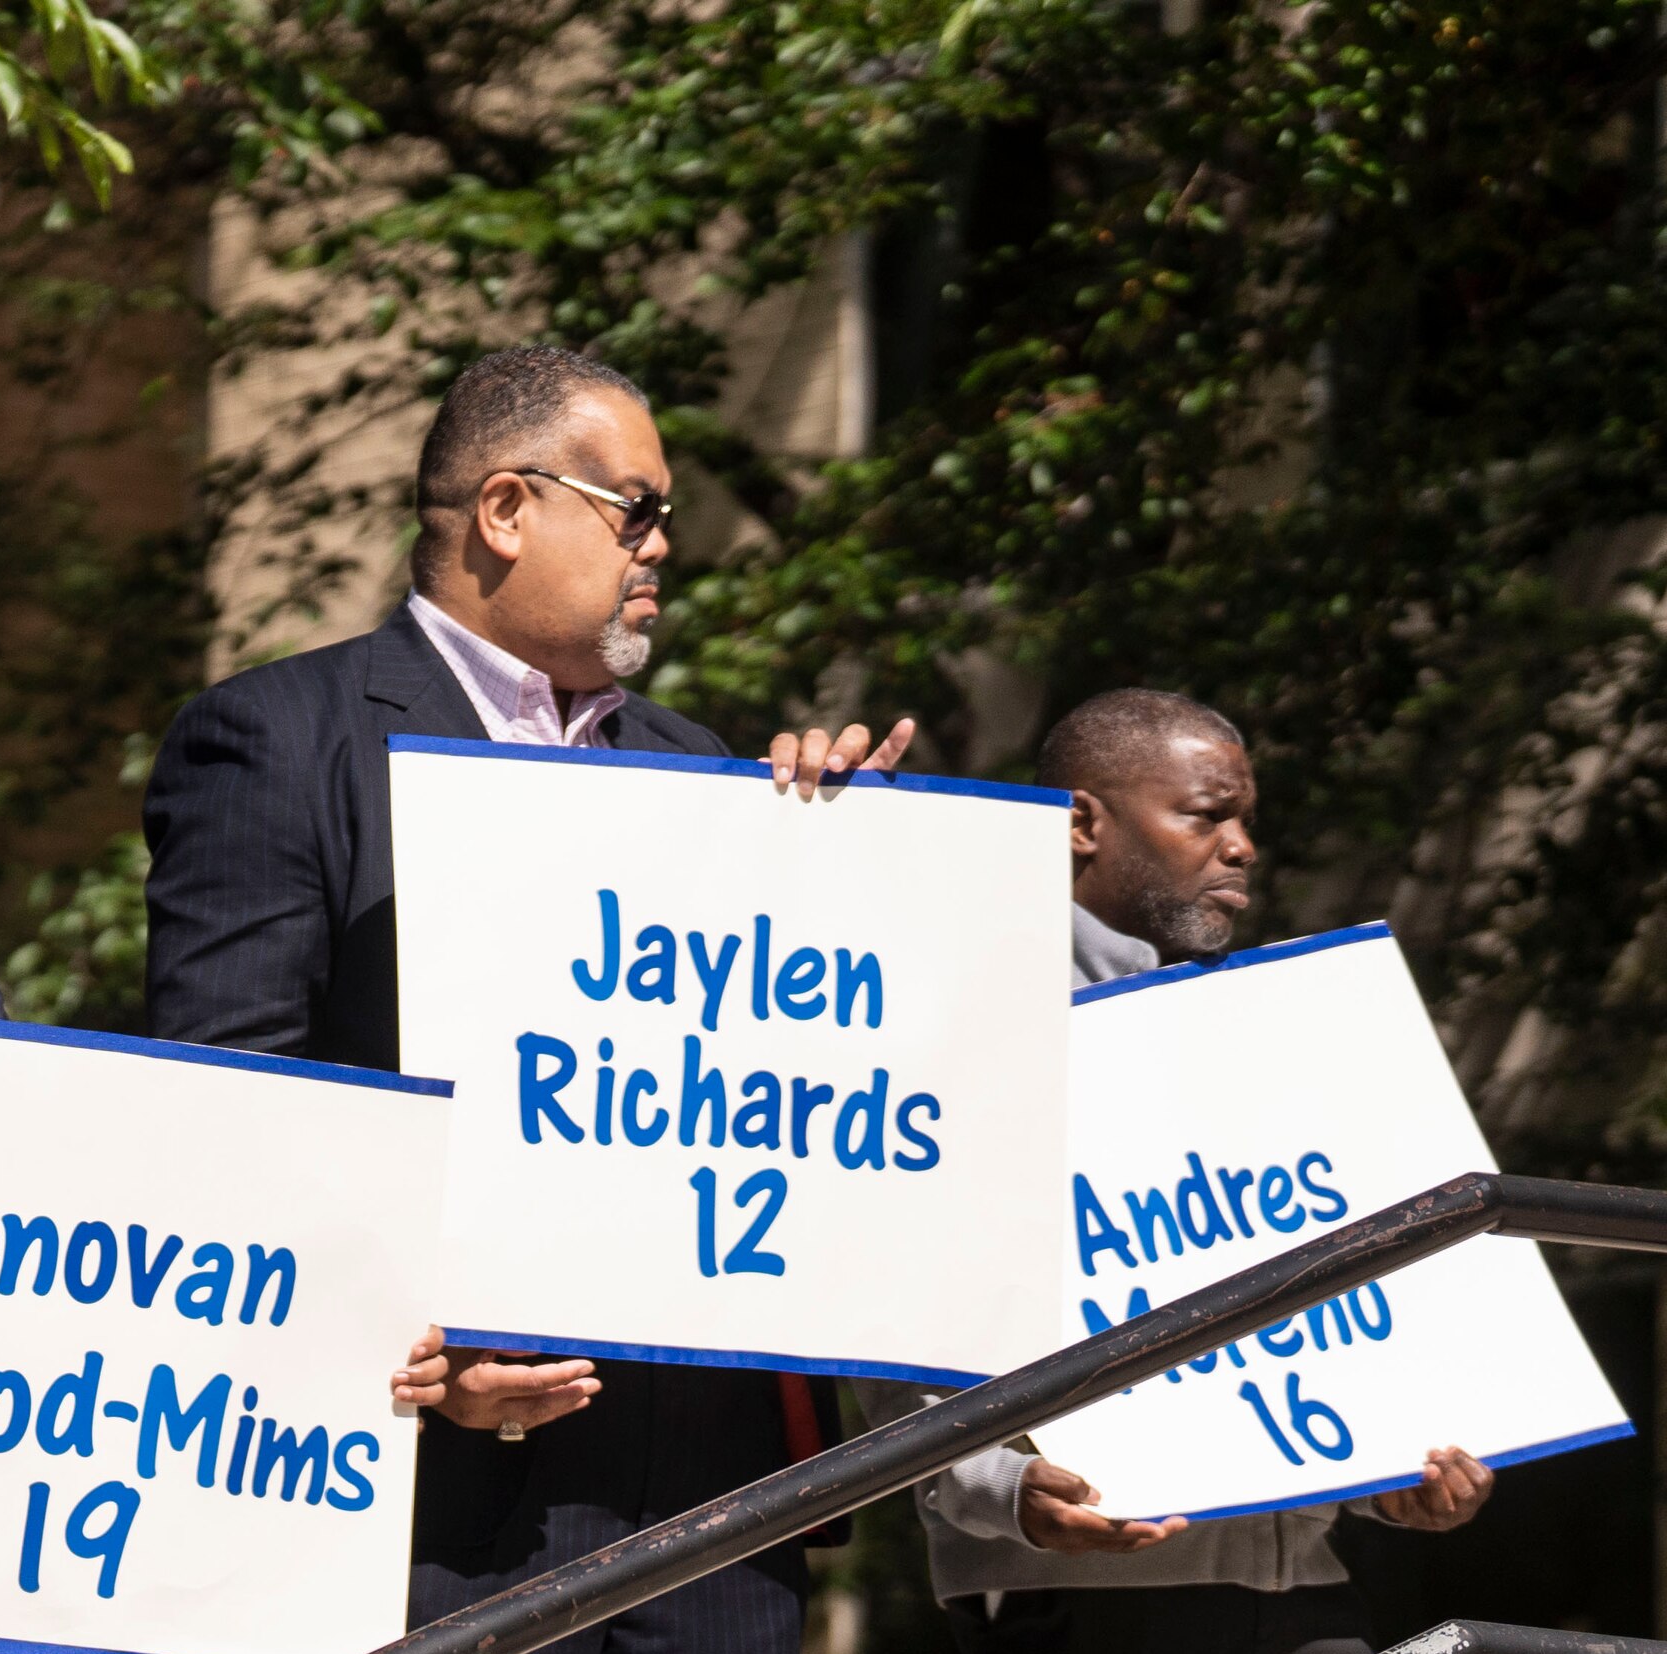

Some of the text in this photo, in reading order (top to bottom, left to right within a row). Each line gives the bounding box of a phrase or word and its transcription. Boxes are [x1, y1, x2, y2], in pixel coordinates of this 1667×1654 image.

[571, 889, 883, 1041] Jaylen
[516, 1032, 940, 1172] Richards
[689, 1167, 788, 1278] 12
[1073, 1152, 1348, 1277] Andres
[1239, 1372, 1354, 1467] 16
[19, 1480, 141, 1599] 19
